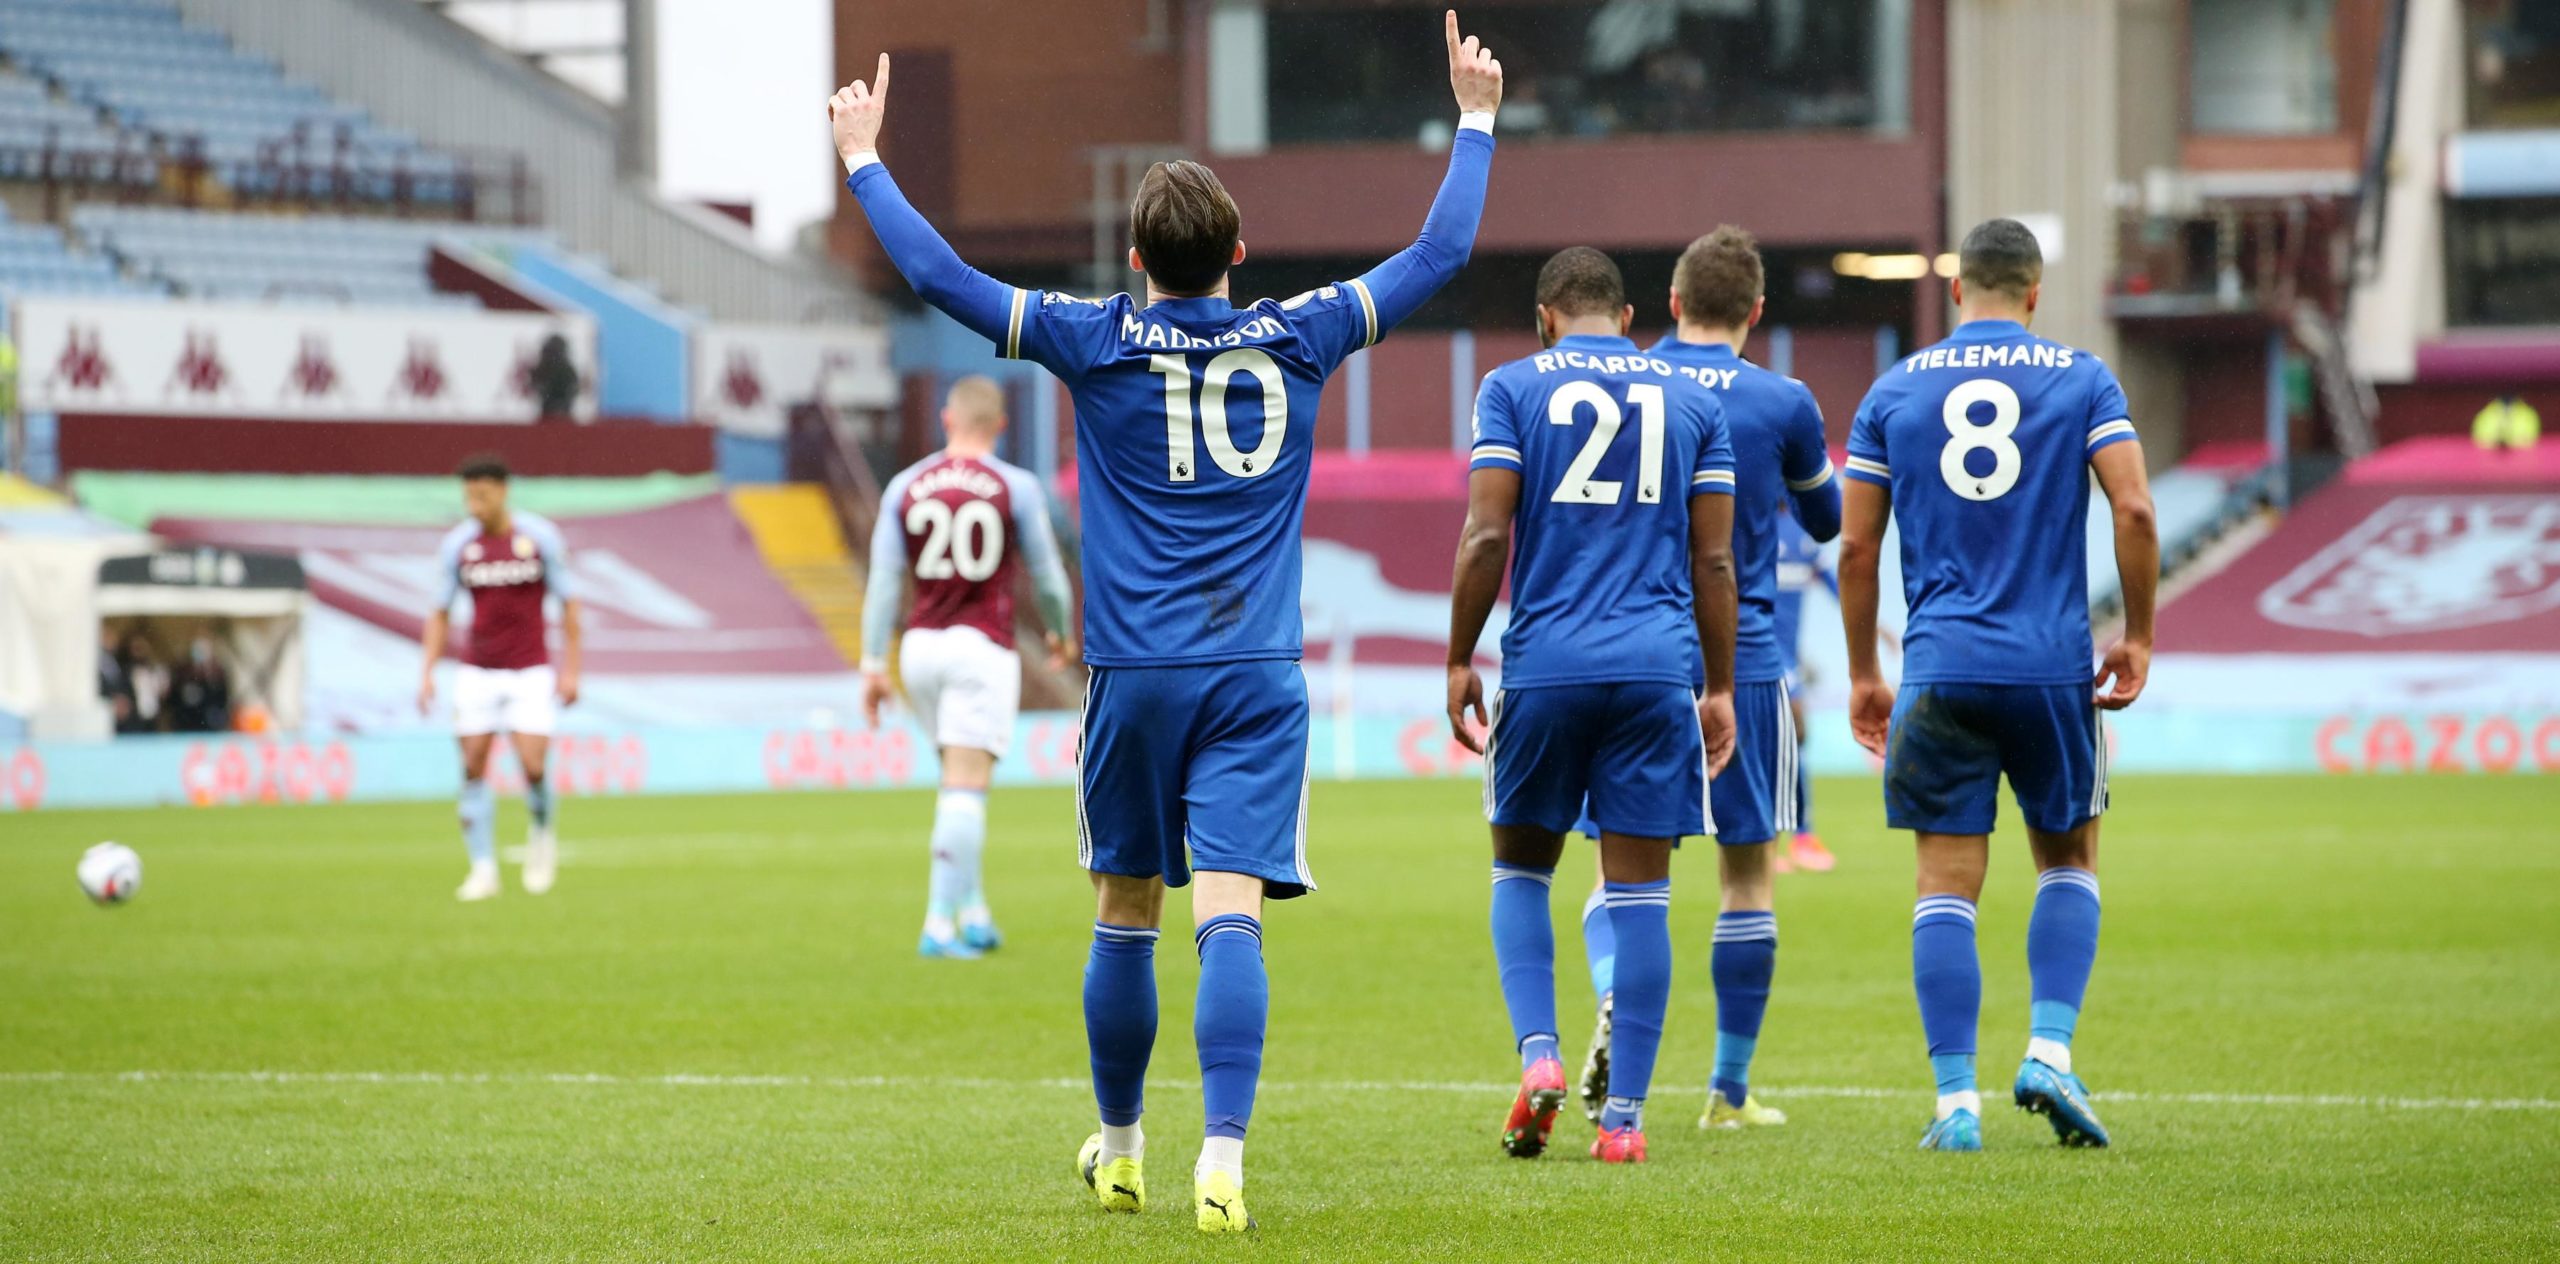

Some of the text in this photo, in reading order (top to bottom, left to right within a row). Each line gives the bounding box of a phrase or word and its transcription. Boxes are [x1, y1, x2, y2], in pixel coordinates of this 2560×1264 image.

[1534, 351, 1673, 376] RICARDO
[1906, 344, 2073, 373] TIELEMANS
[1149, 348, 1288, 481] 10
[1548, 380, 1664, 505] 21
[1940, 378, 2021, 501] 8
[905, 498, 1004, 581] 20
